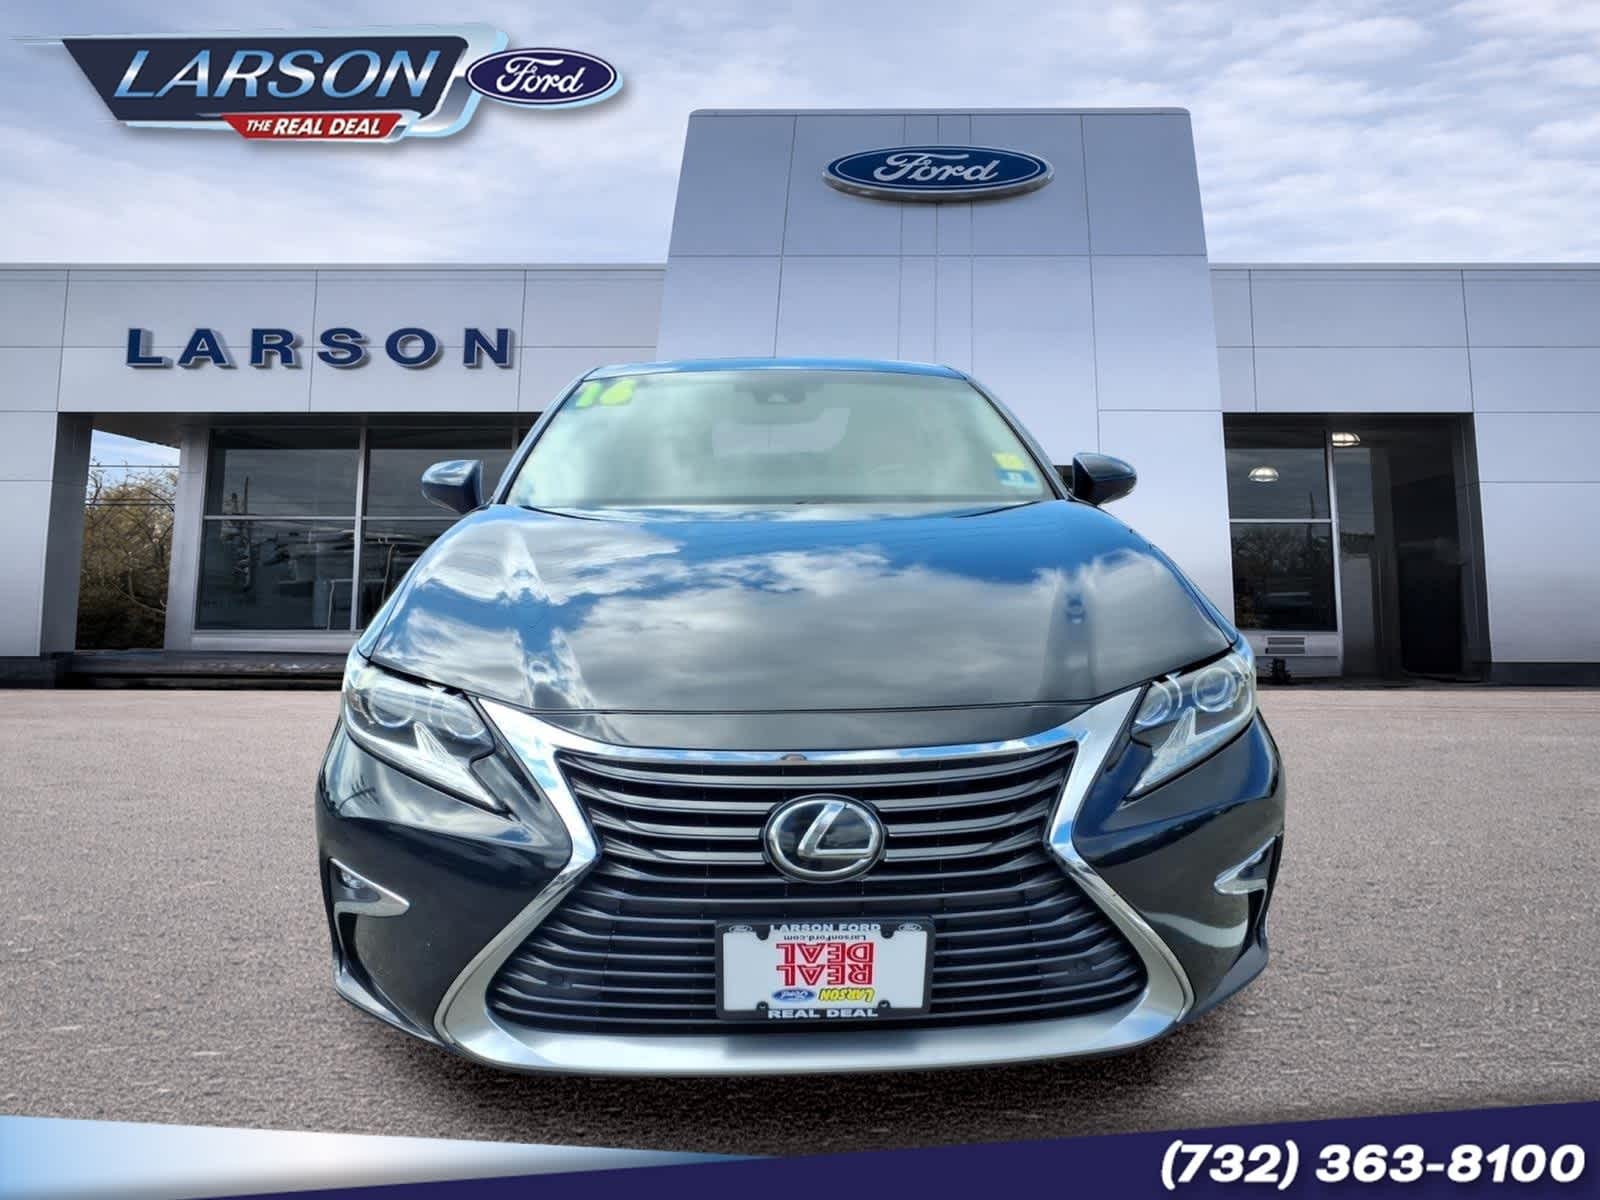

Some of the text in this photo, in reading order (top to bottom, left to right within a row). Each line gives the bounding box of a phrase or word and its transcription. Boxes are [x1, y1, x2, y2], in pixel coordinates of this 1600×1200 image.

[873, 152, 1000, 182] Ford
[126, 327, 513, 368] LARSON
[770, 923, 881, 932] LARSON FORD
[776, 943, 874, 964] DEAL
[776, 964, 874, 986] REAL
[768, 1008, 879, 1019] REAL DEAL
